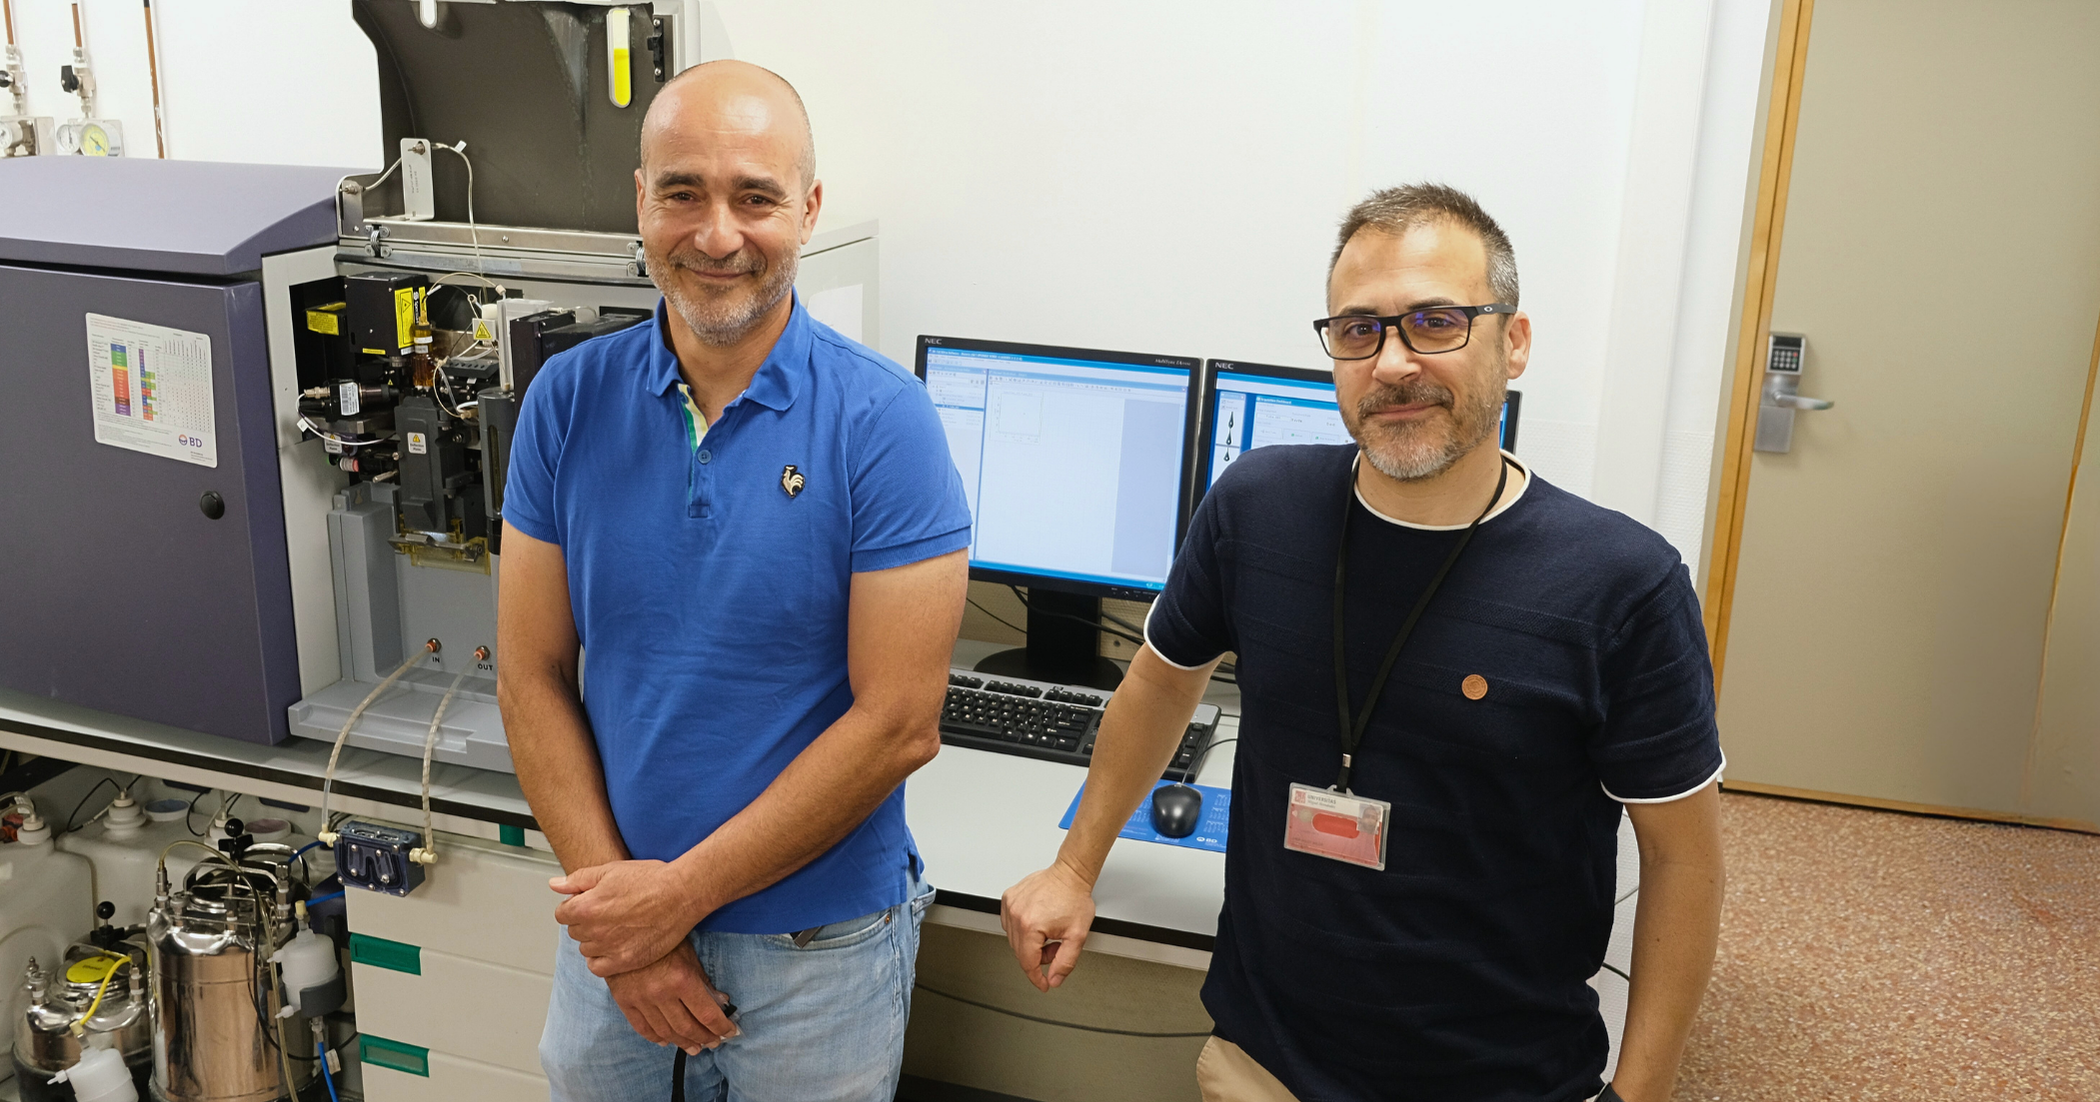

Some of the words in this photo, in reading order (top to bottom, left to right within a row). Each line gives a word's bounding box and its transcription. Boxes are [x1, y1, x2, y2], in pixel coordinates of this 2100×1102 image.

[924, 337, 942, 345] NEC
[1215, 361, 1234, 370] NEC
[188, 437, 202, 448] BD
[477, 663, 493, 671] OUT
